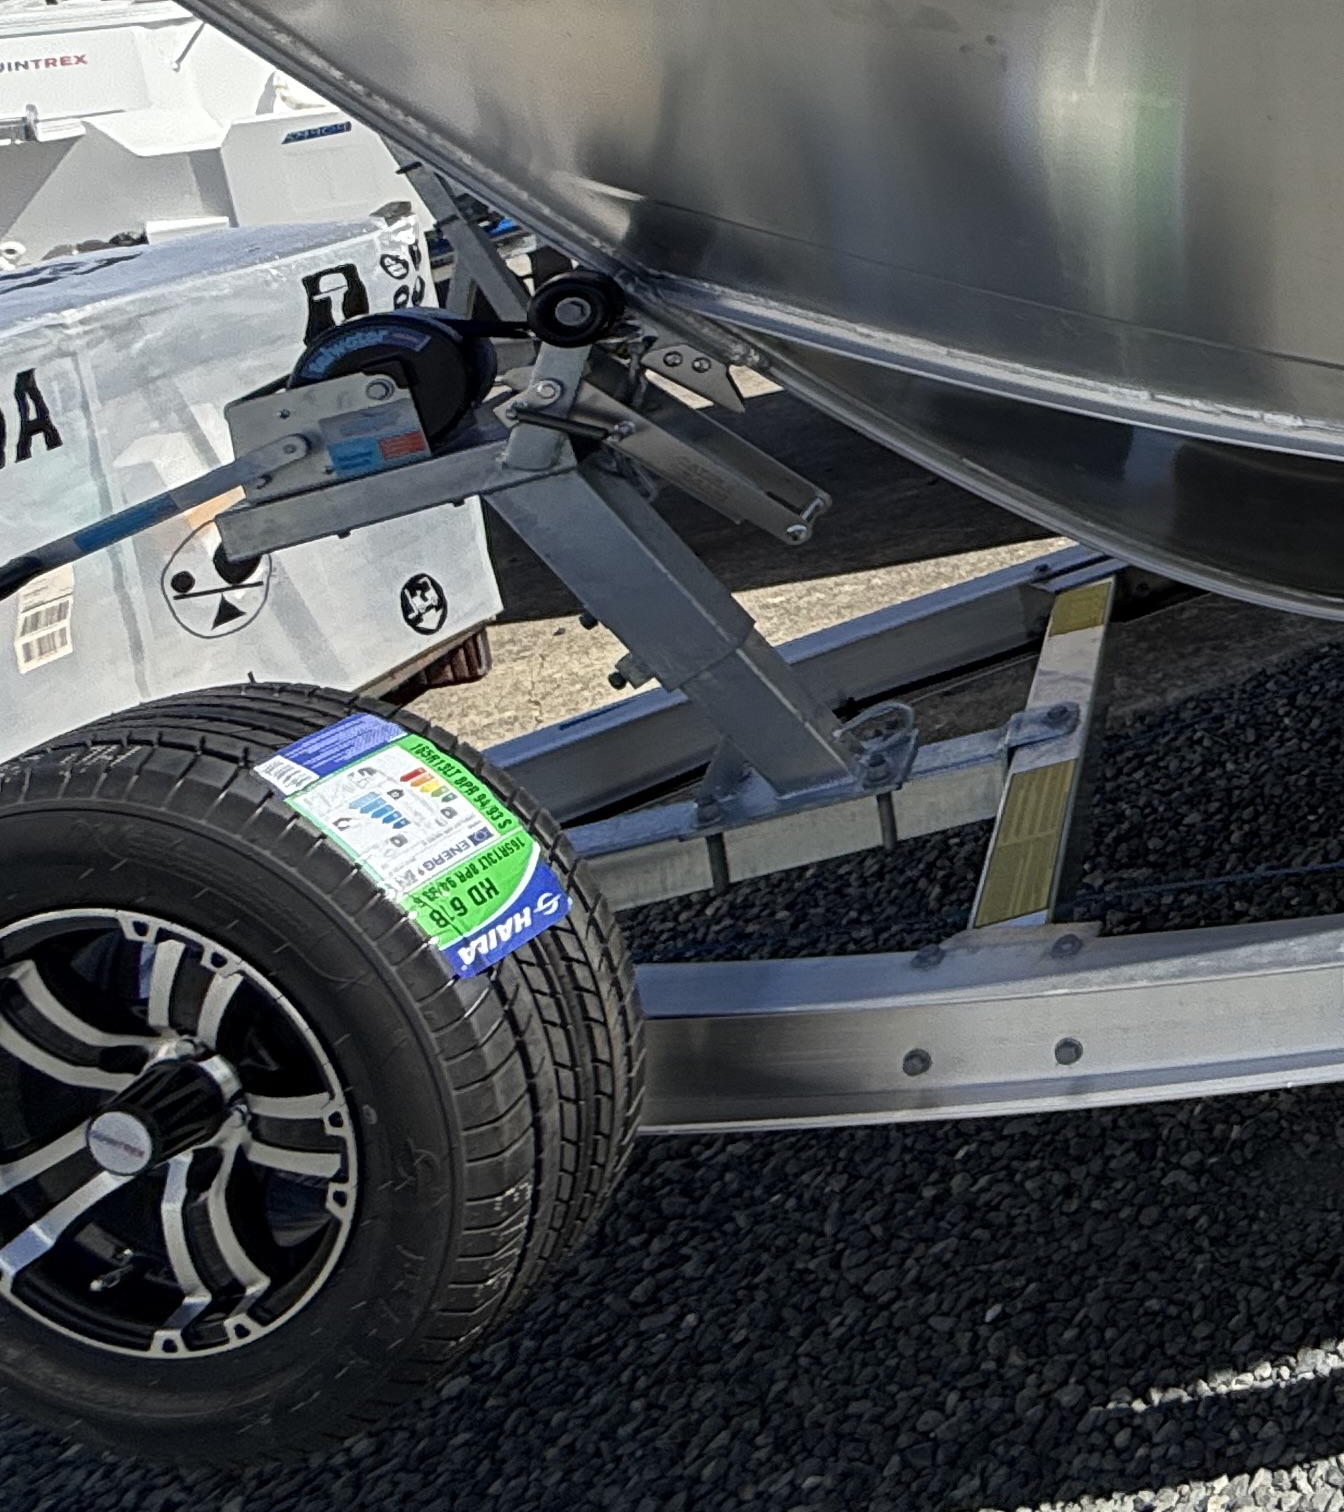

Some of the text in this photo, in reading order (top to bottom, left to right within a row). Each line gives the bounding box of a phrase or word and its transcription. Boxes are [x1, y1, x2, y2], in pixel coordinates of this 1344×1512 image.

[498, 818, 513, 830] S
[477, 836, 526, 871] 165R13LT
[454, 862, 480, 884] 8PR
[466, 876, 500, 907] HD
